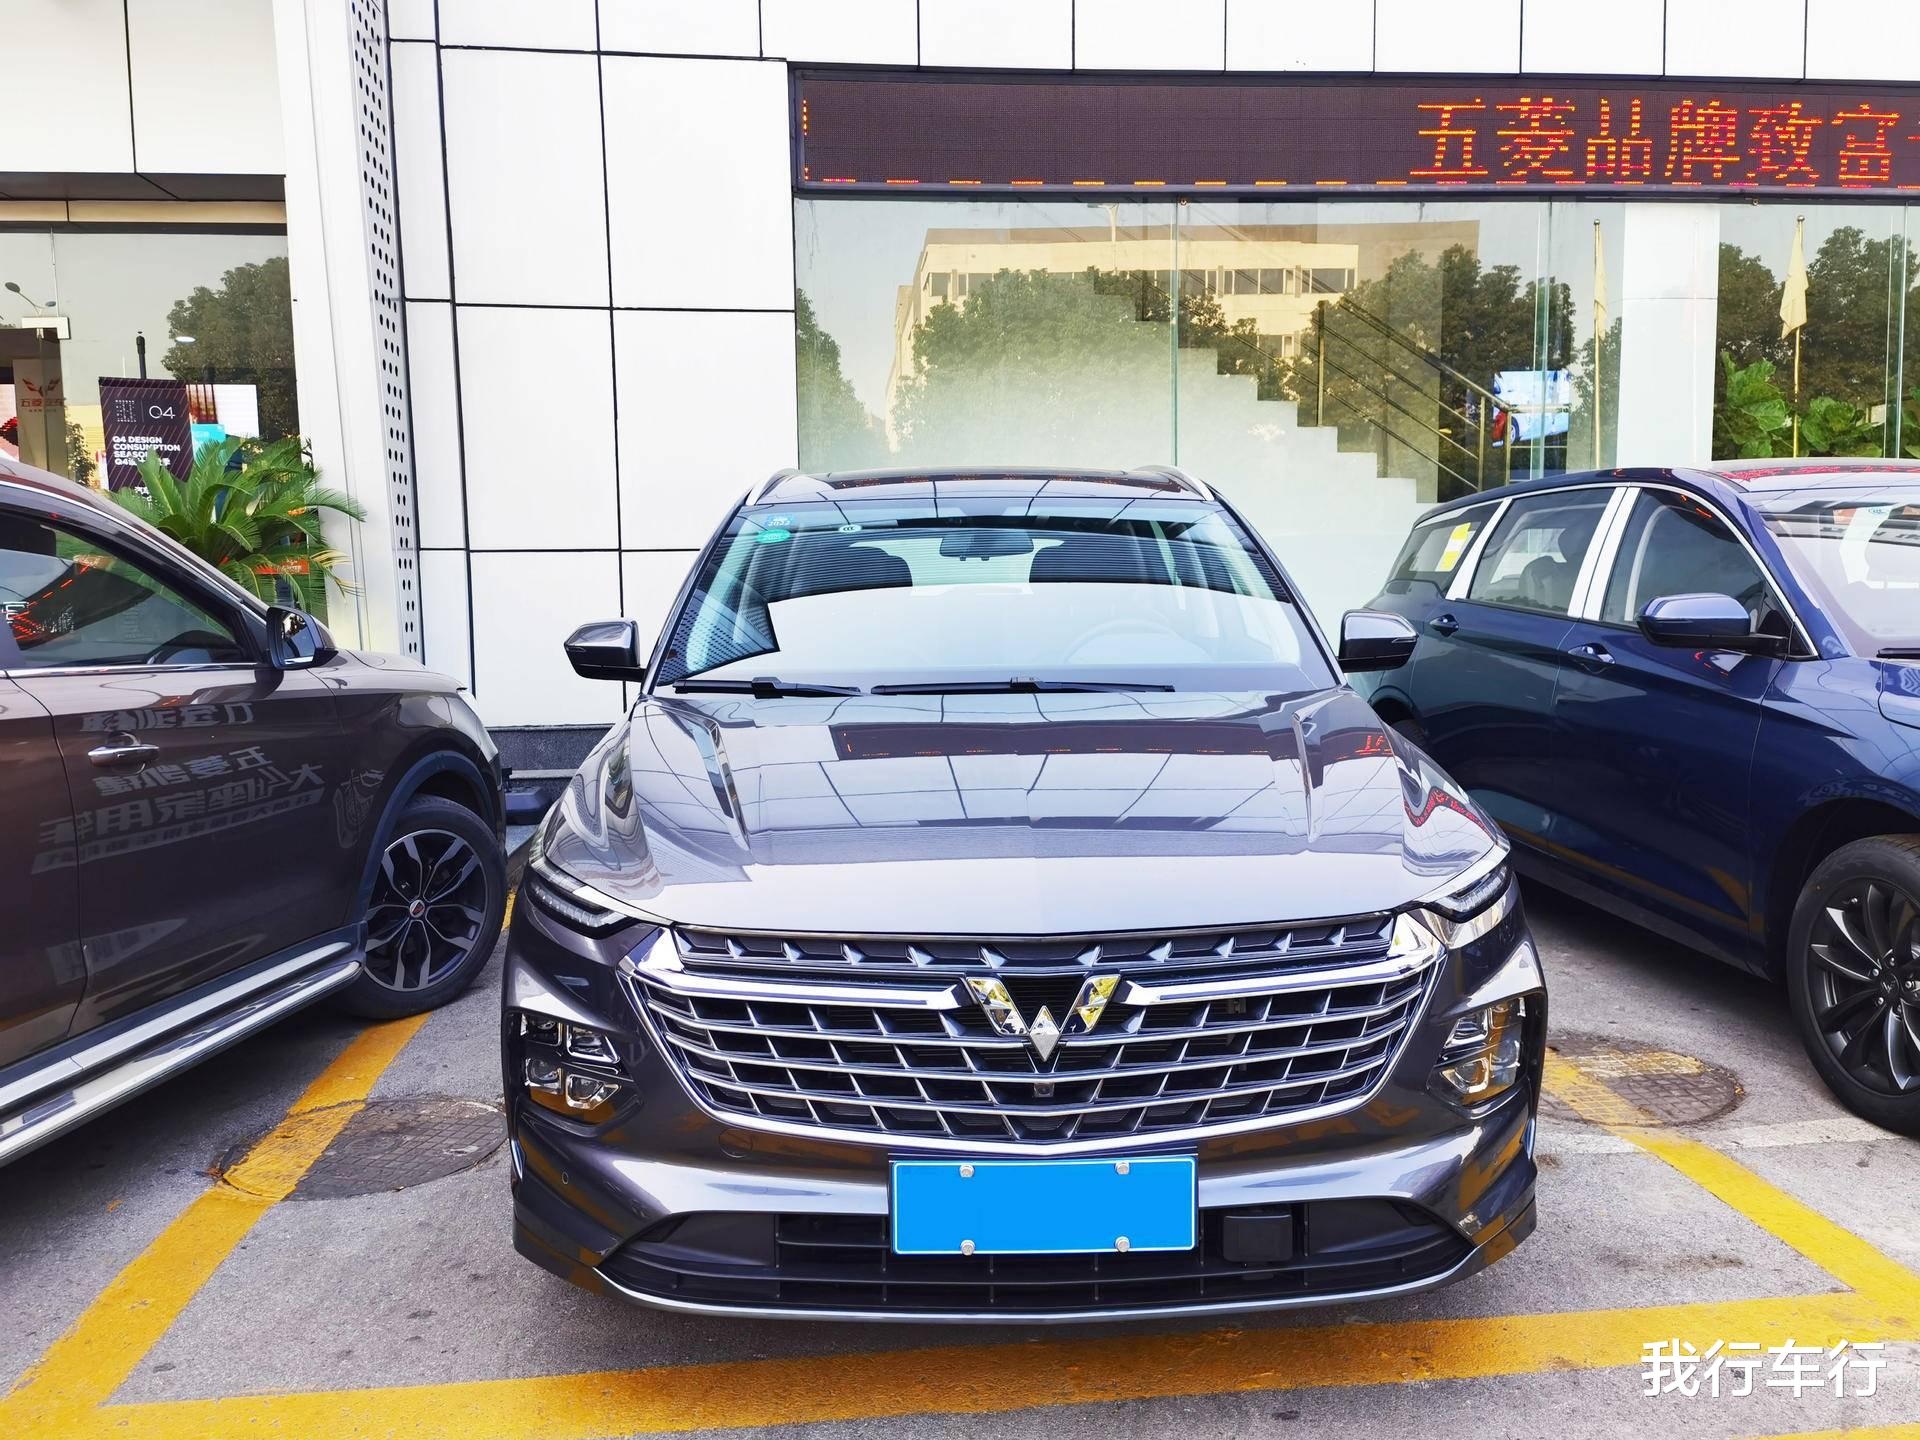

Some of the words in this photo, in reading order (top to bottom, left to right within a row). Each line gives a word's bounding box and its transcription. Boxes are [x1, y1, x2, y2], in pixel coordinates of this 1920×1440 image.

[1410, 97, 1920, 180] 五菱品牌致富
[128, 436, 162, 444] DESIGN
[114, 450, 148, 458] SEASO
